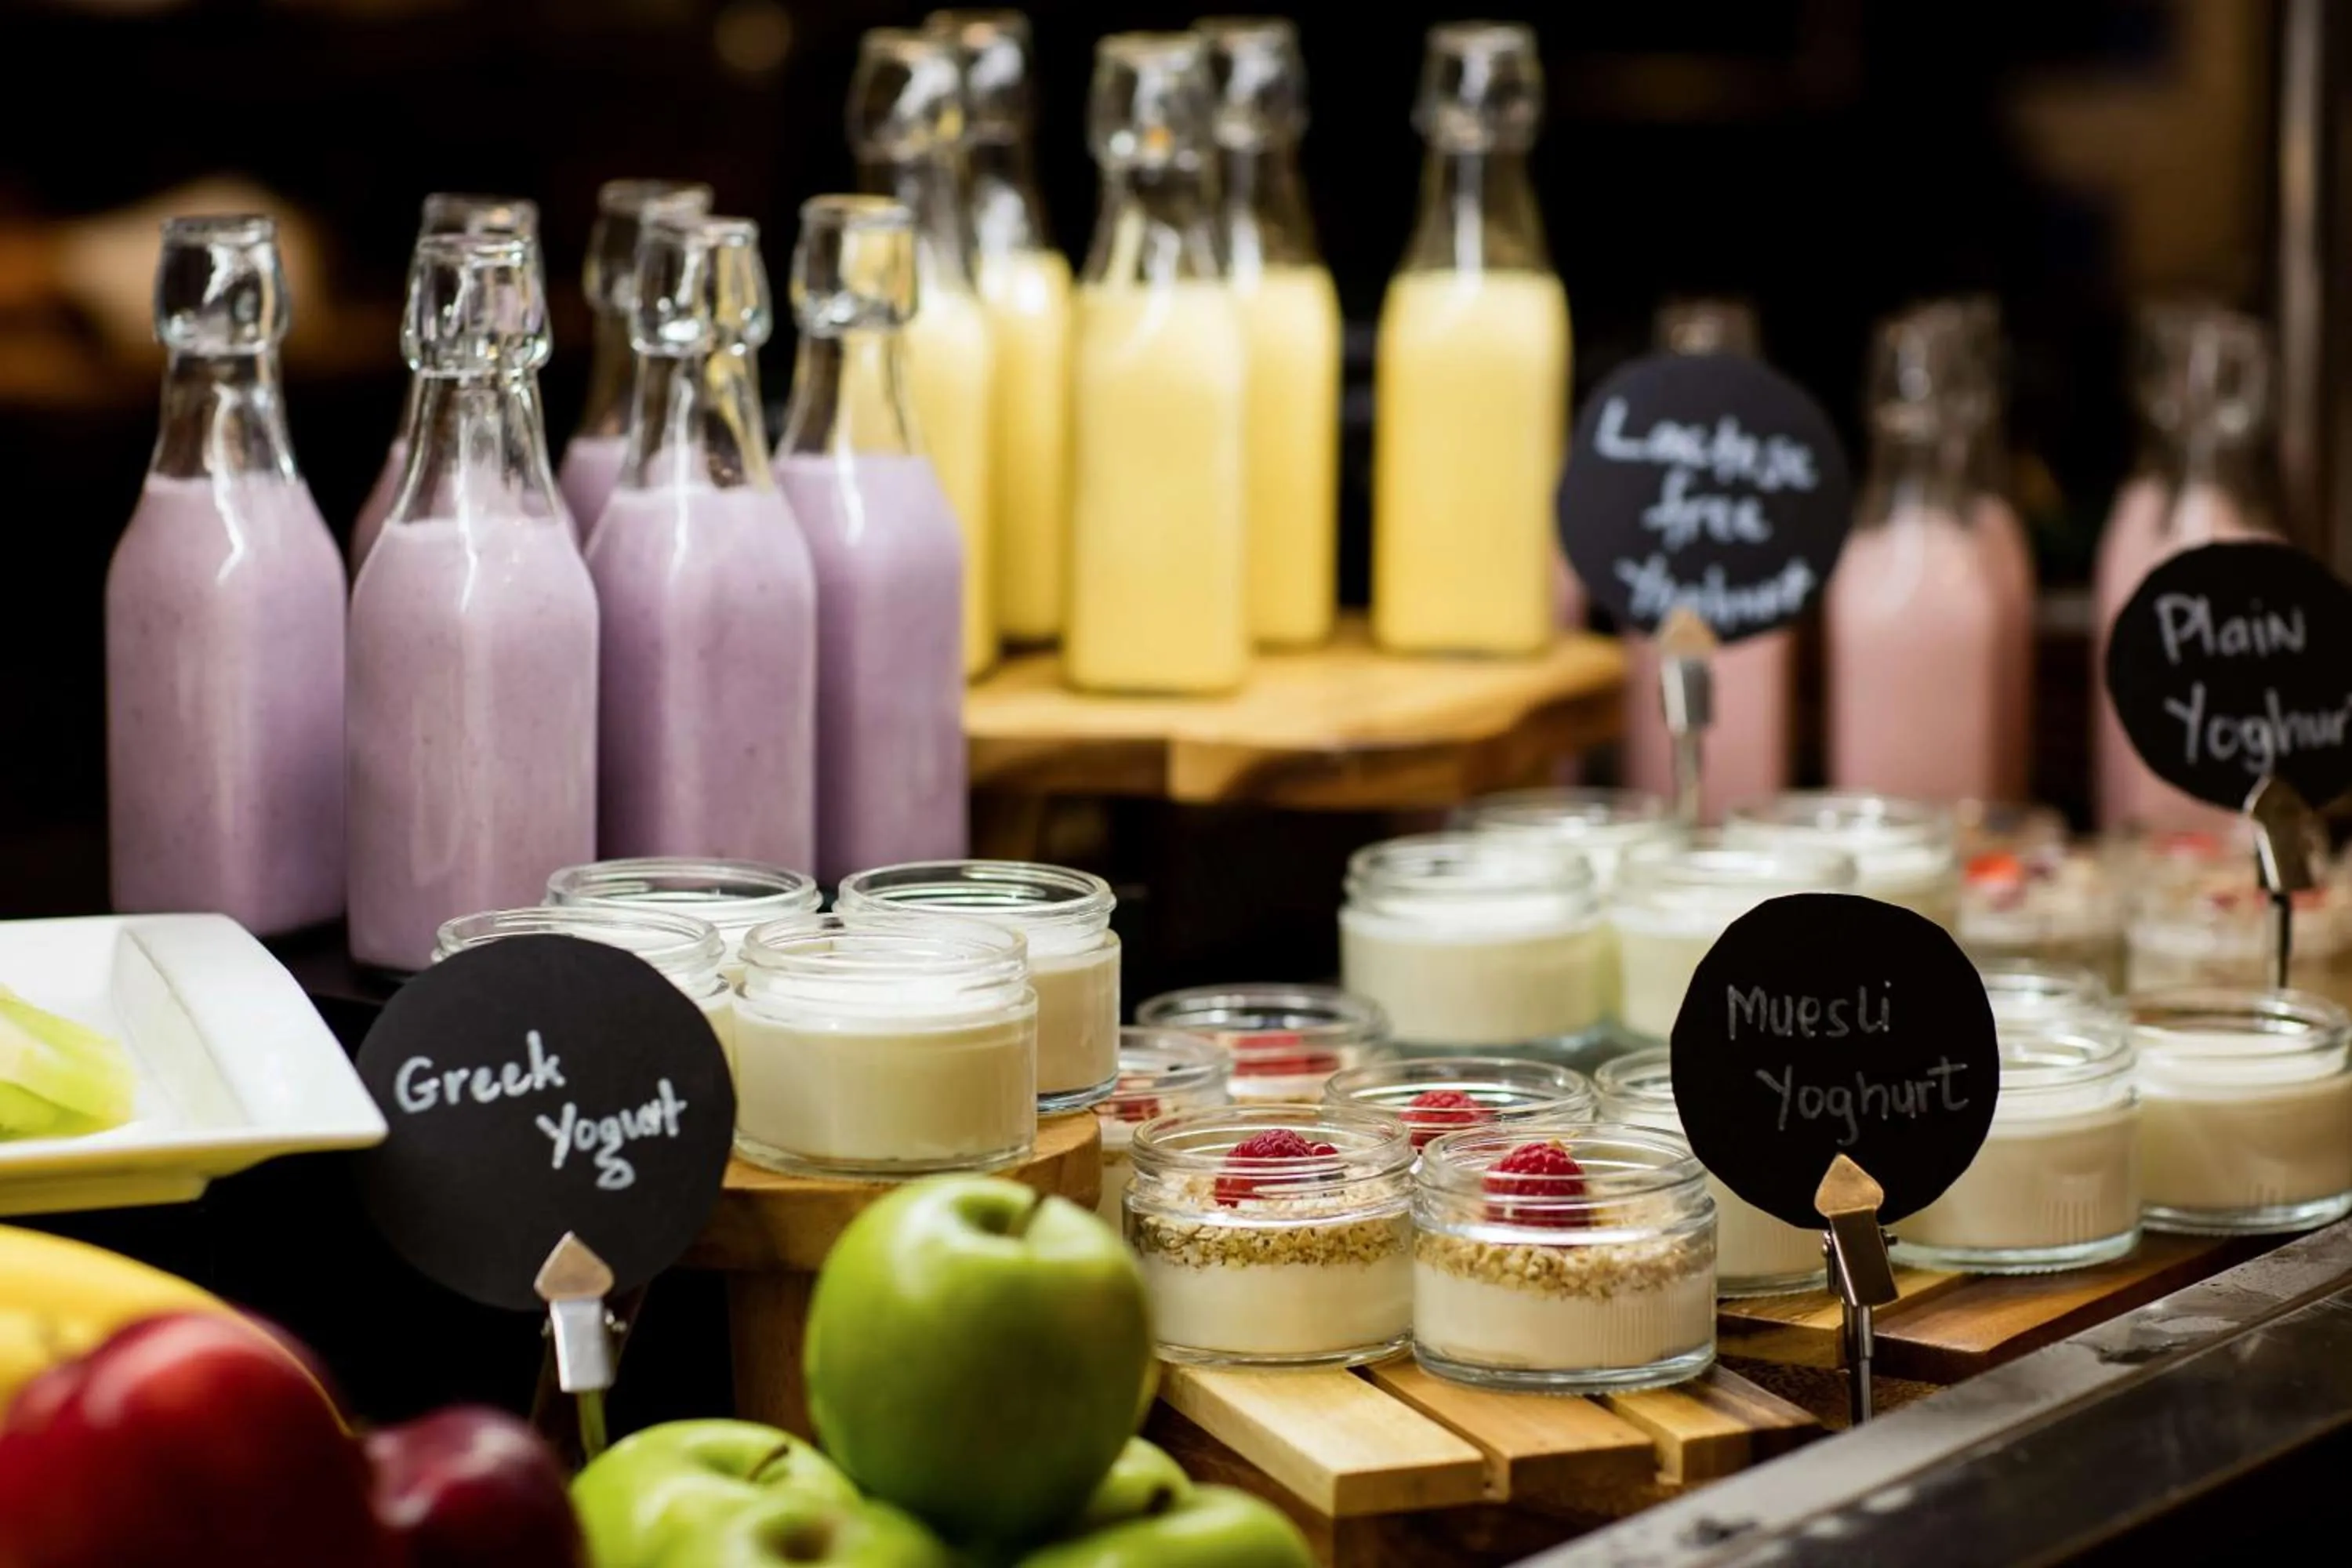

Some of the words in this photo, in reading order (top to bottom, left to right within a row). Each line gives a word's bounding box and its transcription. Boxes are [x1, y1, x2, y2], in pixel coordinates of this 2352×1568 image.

[2163, 680, 2352, 775] Yoghur
[1727, 980, 1892, 1041] Muesli
[396, 1029, 566, 1112] Greek
[1755, 1054, 1969, 1146] Yoghurt
[535, 1078, 688, 1190] Yogurt
